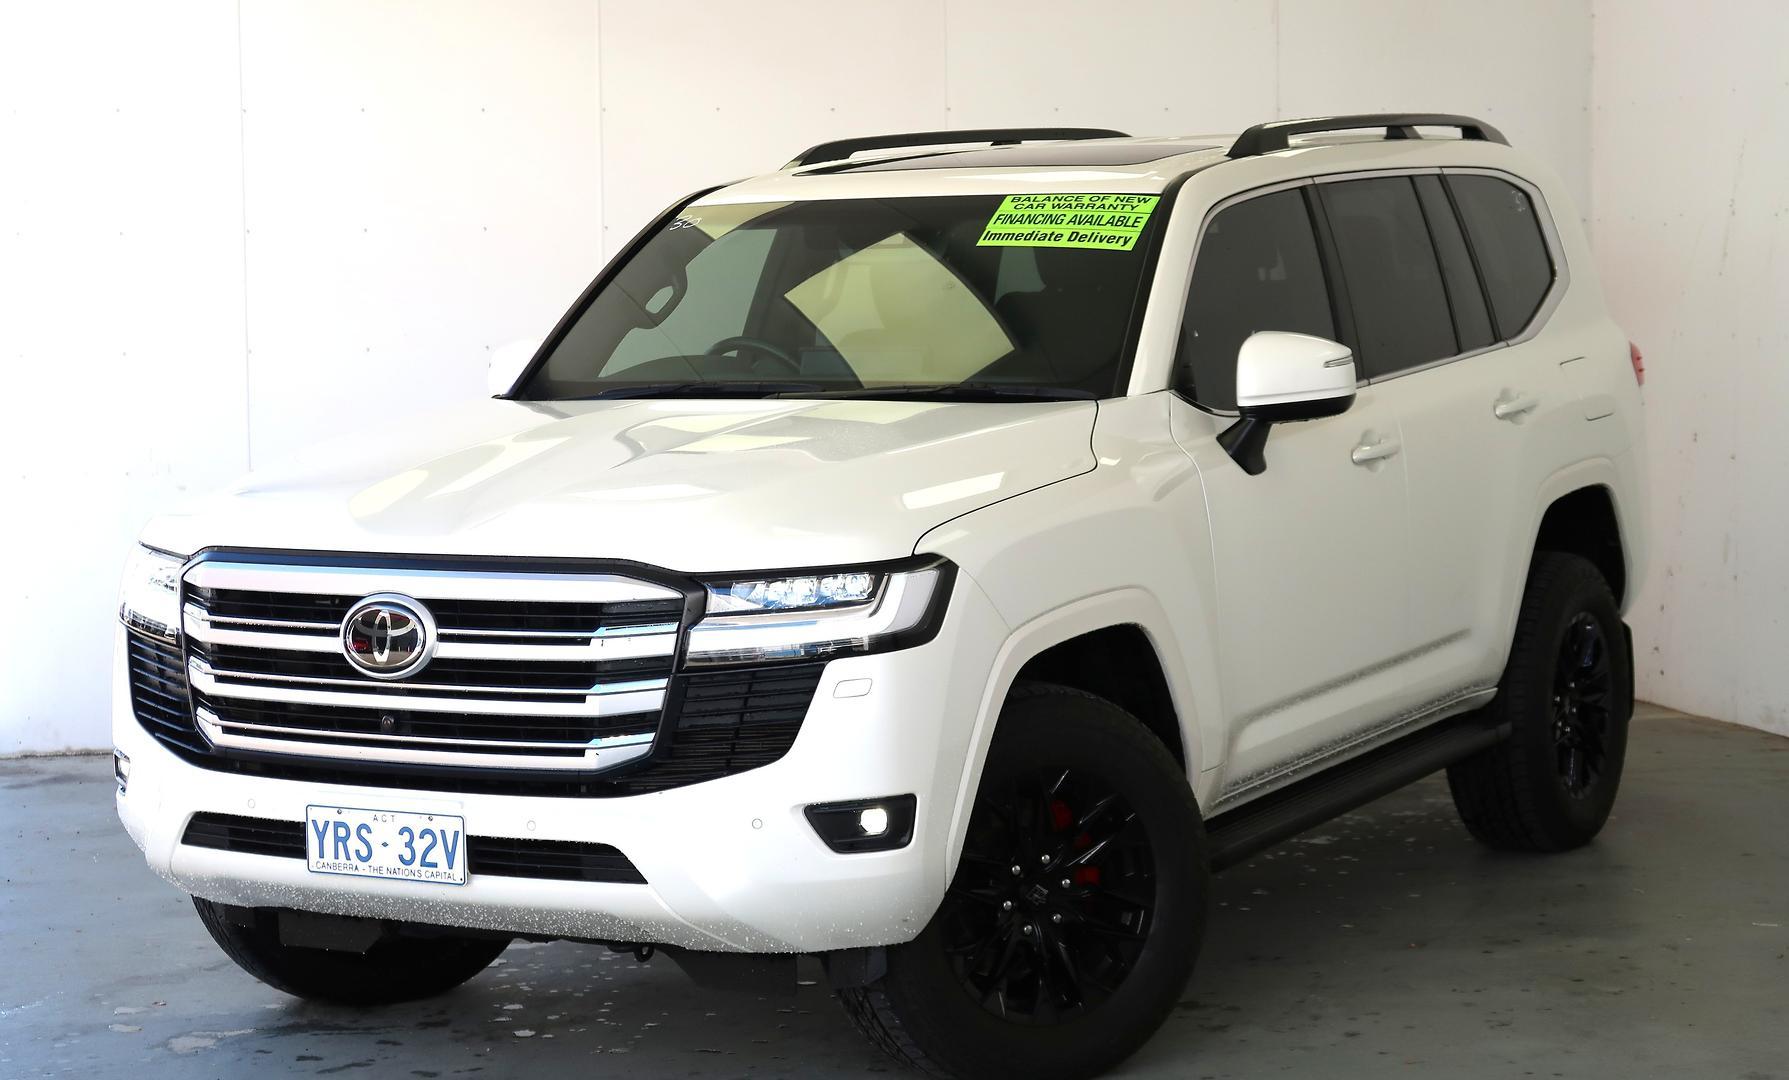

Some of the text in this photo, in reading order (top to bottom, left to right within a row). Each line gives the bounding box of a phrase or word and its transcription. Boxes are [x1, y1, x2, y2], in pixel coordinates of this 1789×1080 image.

[1010, 195, 1153, 204] BALANCE OF NEW
[1013, 202, 1140, 211] CAR WARRANTY
[993, 213, 1144, 228] FINANCING AVAILABLE
[982, 230, 1133, 247] Immediate Delivery
[311, 819, 460, 870] YRS 32V
[315, 861, 360, 873] CANBERRA
[368, 865, 384, 876] THE
[424, 870, 457, 882] CAPITAL
